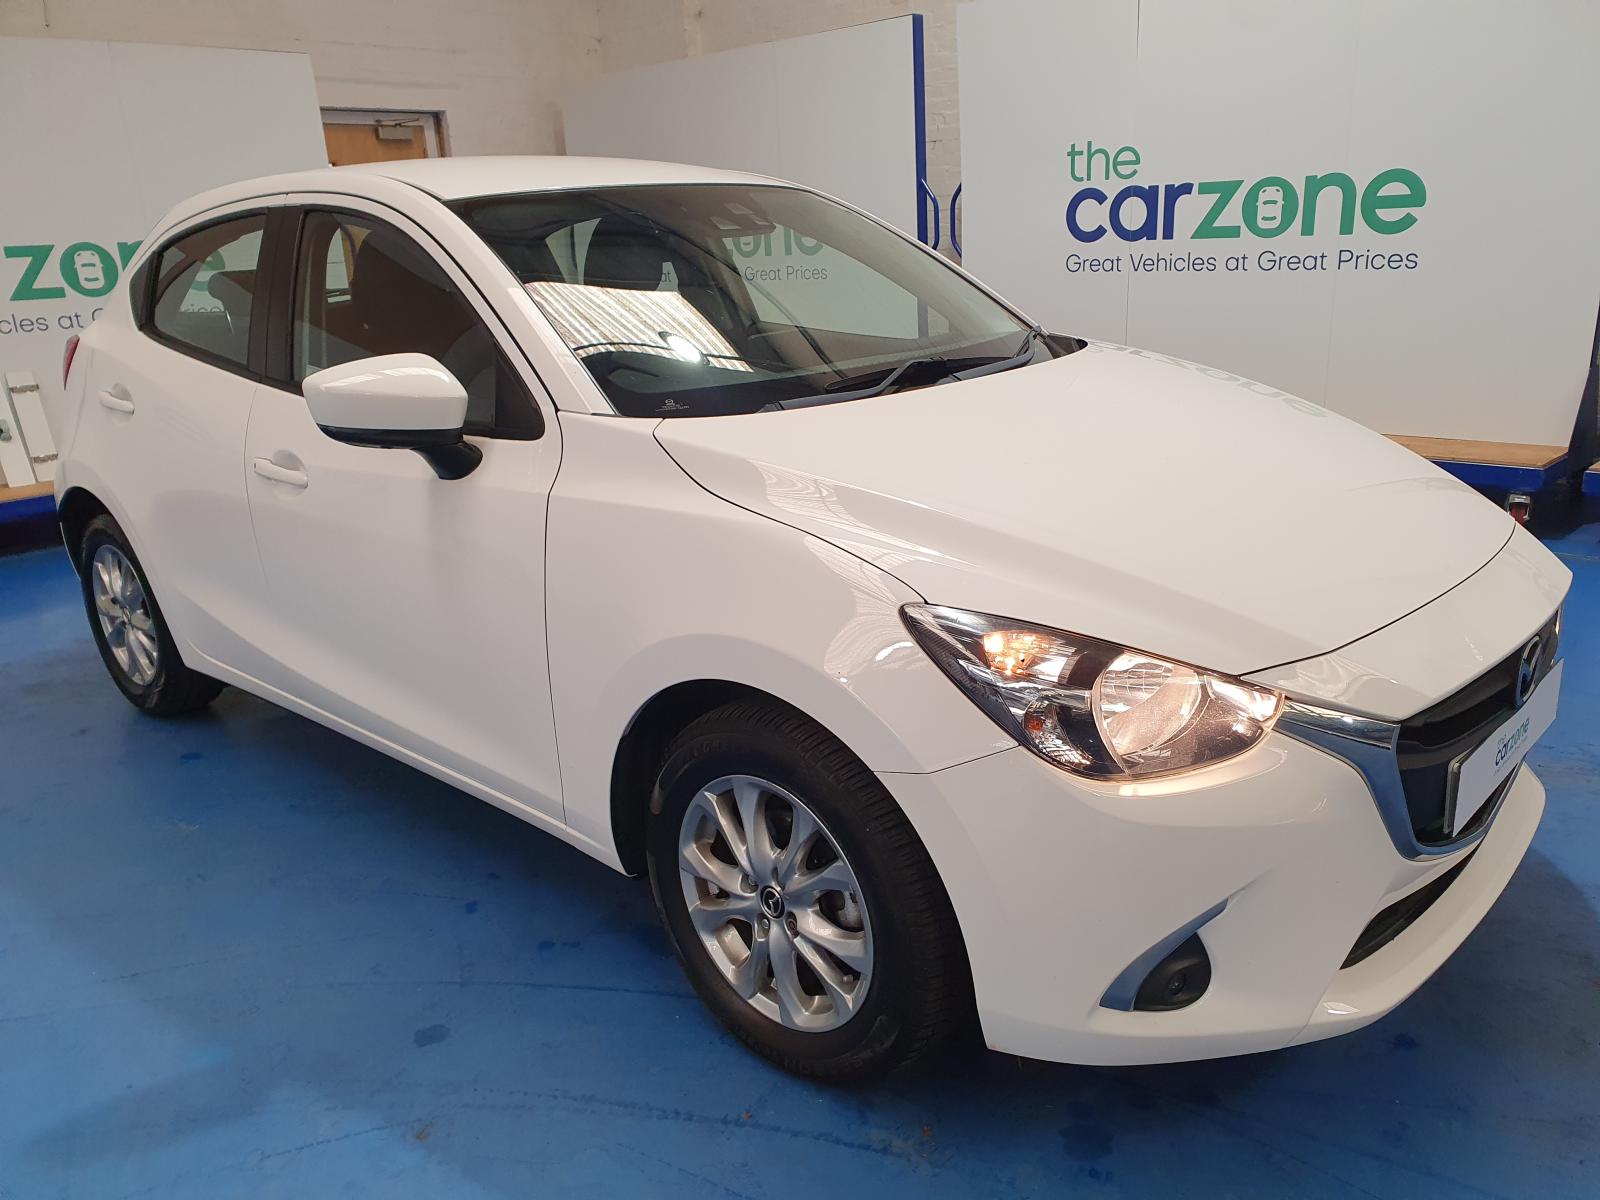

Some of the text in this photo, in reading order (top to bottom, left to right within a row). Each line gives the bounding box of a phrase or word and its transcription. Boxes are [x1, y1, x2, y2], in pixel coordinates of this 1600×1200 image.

[1067, 141, 1141, 182] the
[1066, 167, 1427, 243] carzone
[744, 266, 782, 281] Great
[786, 264, 828, 280] Prices
[1066, 249, 1419, 273] Great Vehicles at Great Prices
[57, 312, 84, 329] at
